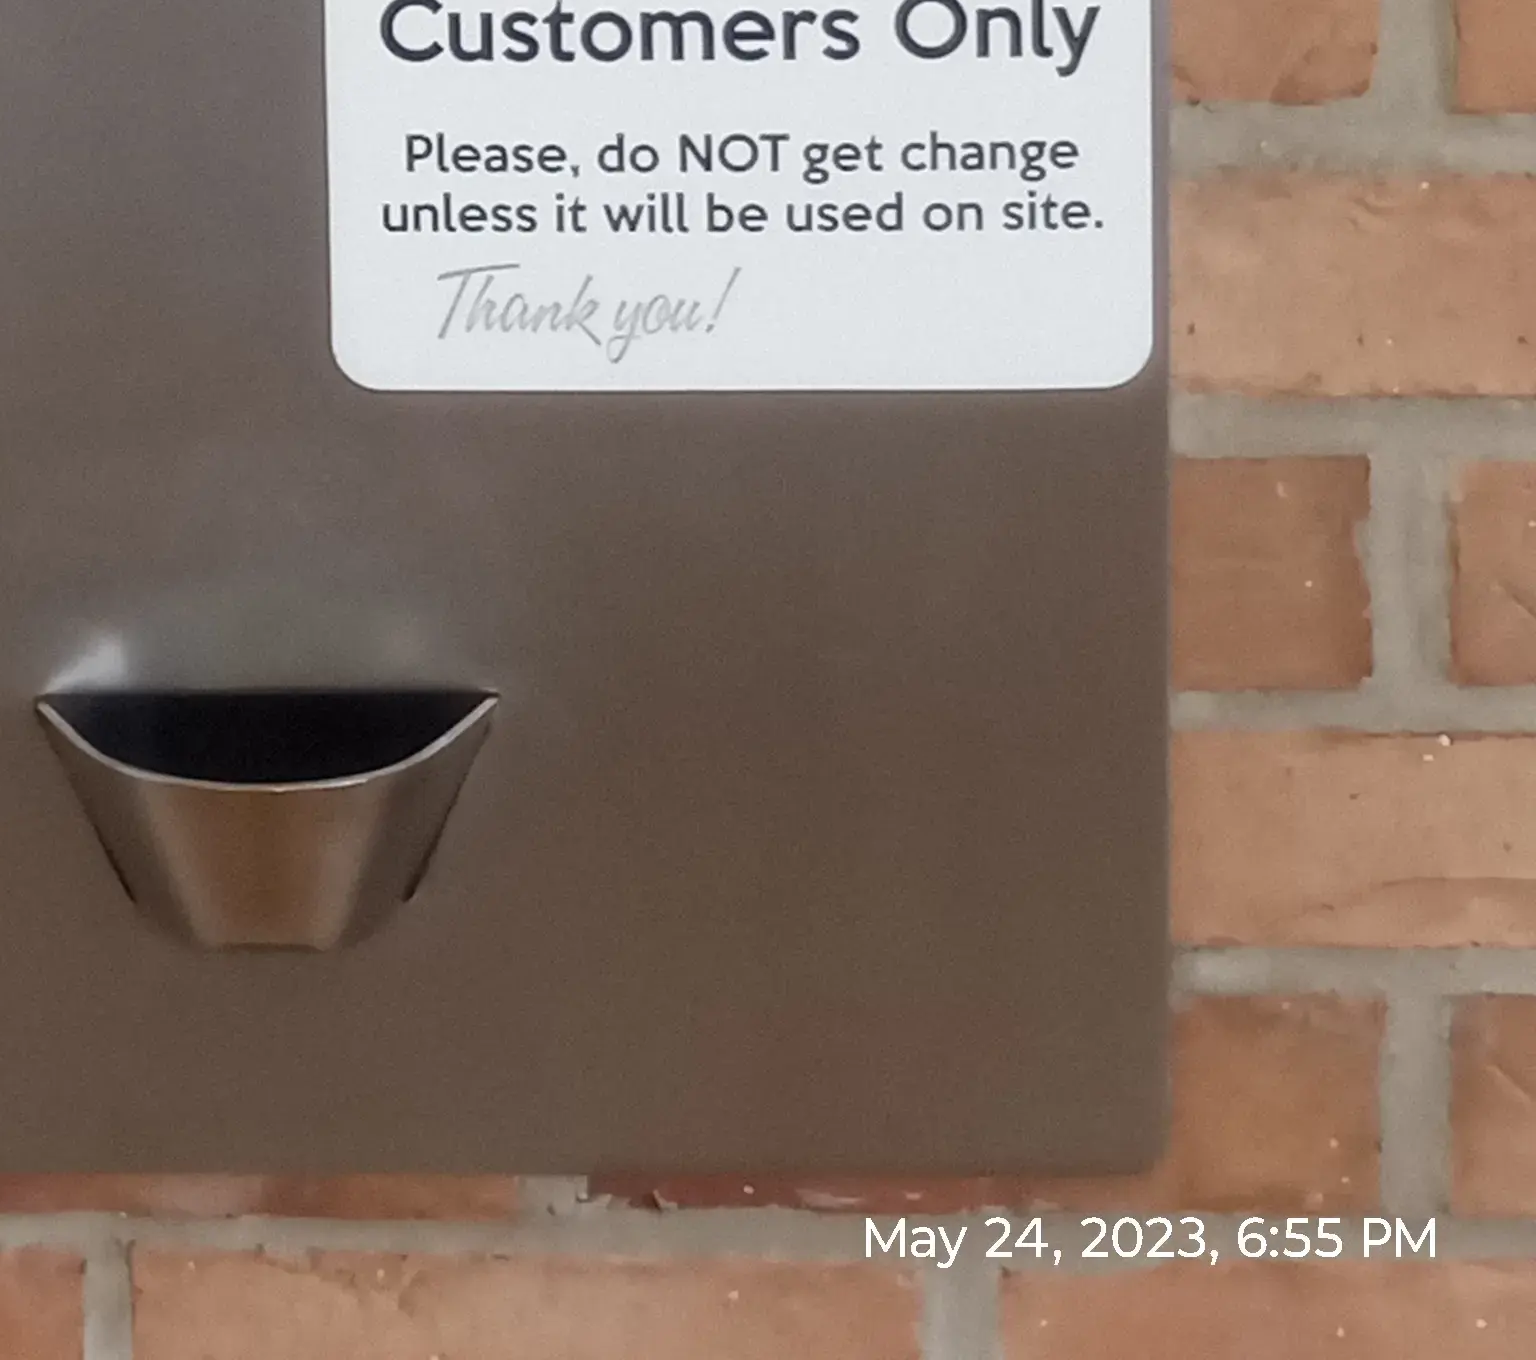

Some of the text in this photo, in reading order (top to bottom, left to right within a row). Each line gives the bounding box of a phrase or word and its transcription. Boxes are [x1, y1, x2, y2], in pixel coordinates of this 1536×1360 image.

[405, 130, 1080, 185] Please, do NOT get change
[382, 189, 1104, 234] unless it will be used on site.
[437, 263, 742, 364] Thank you!
